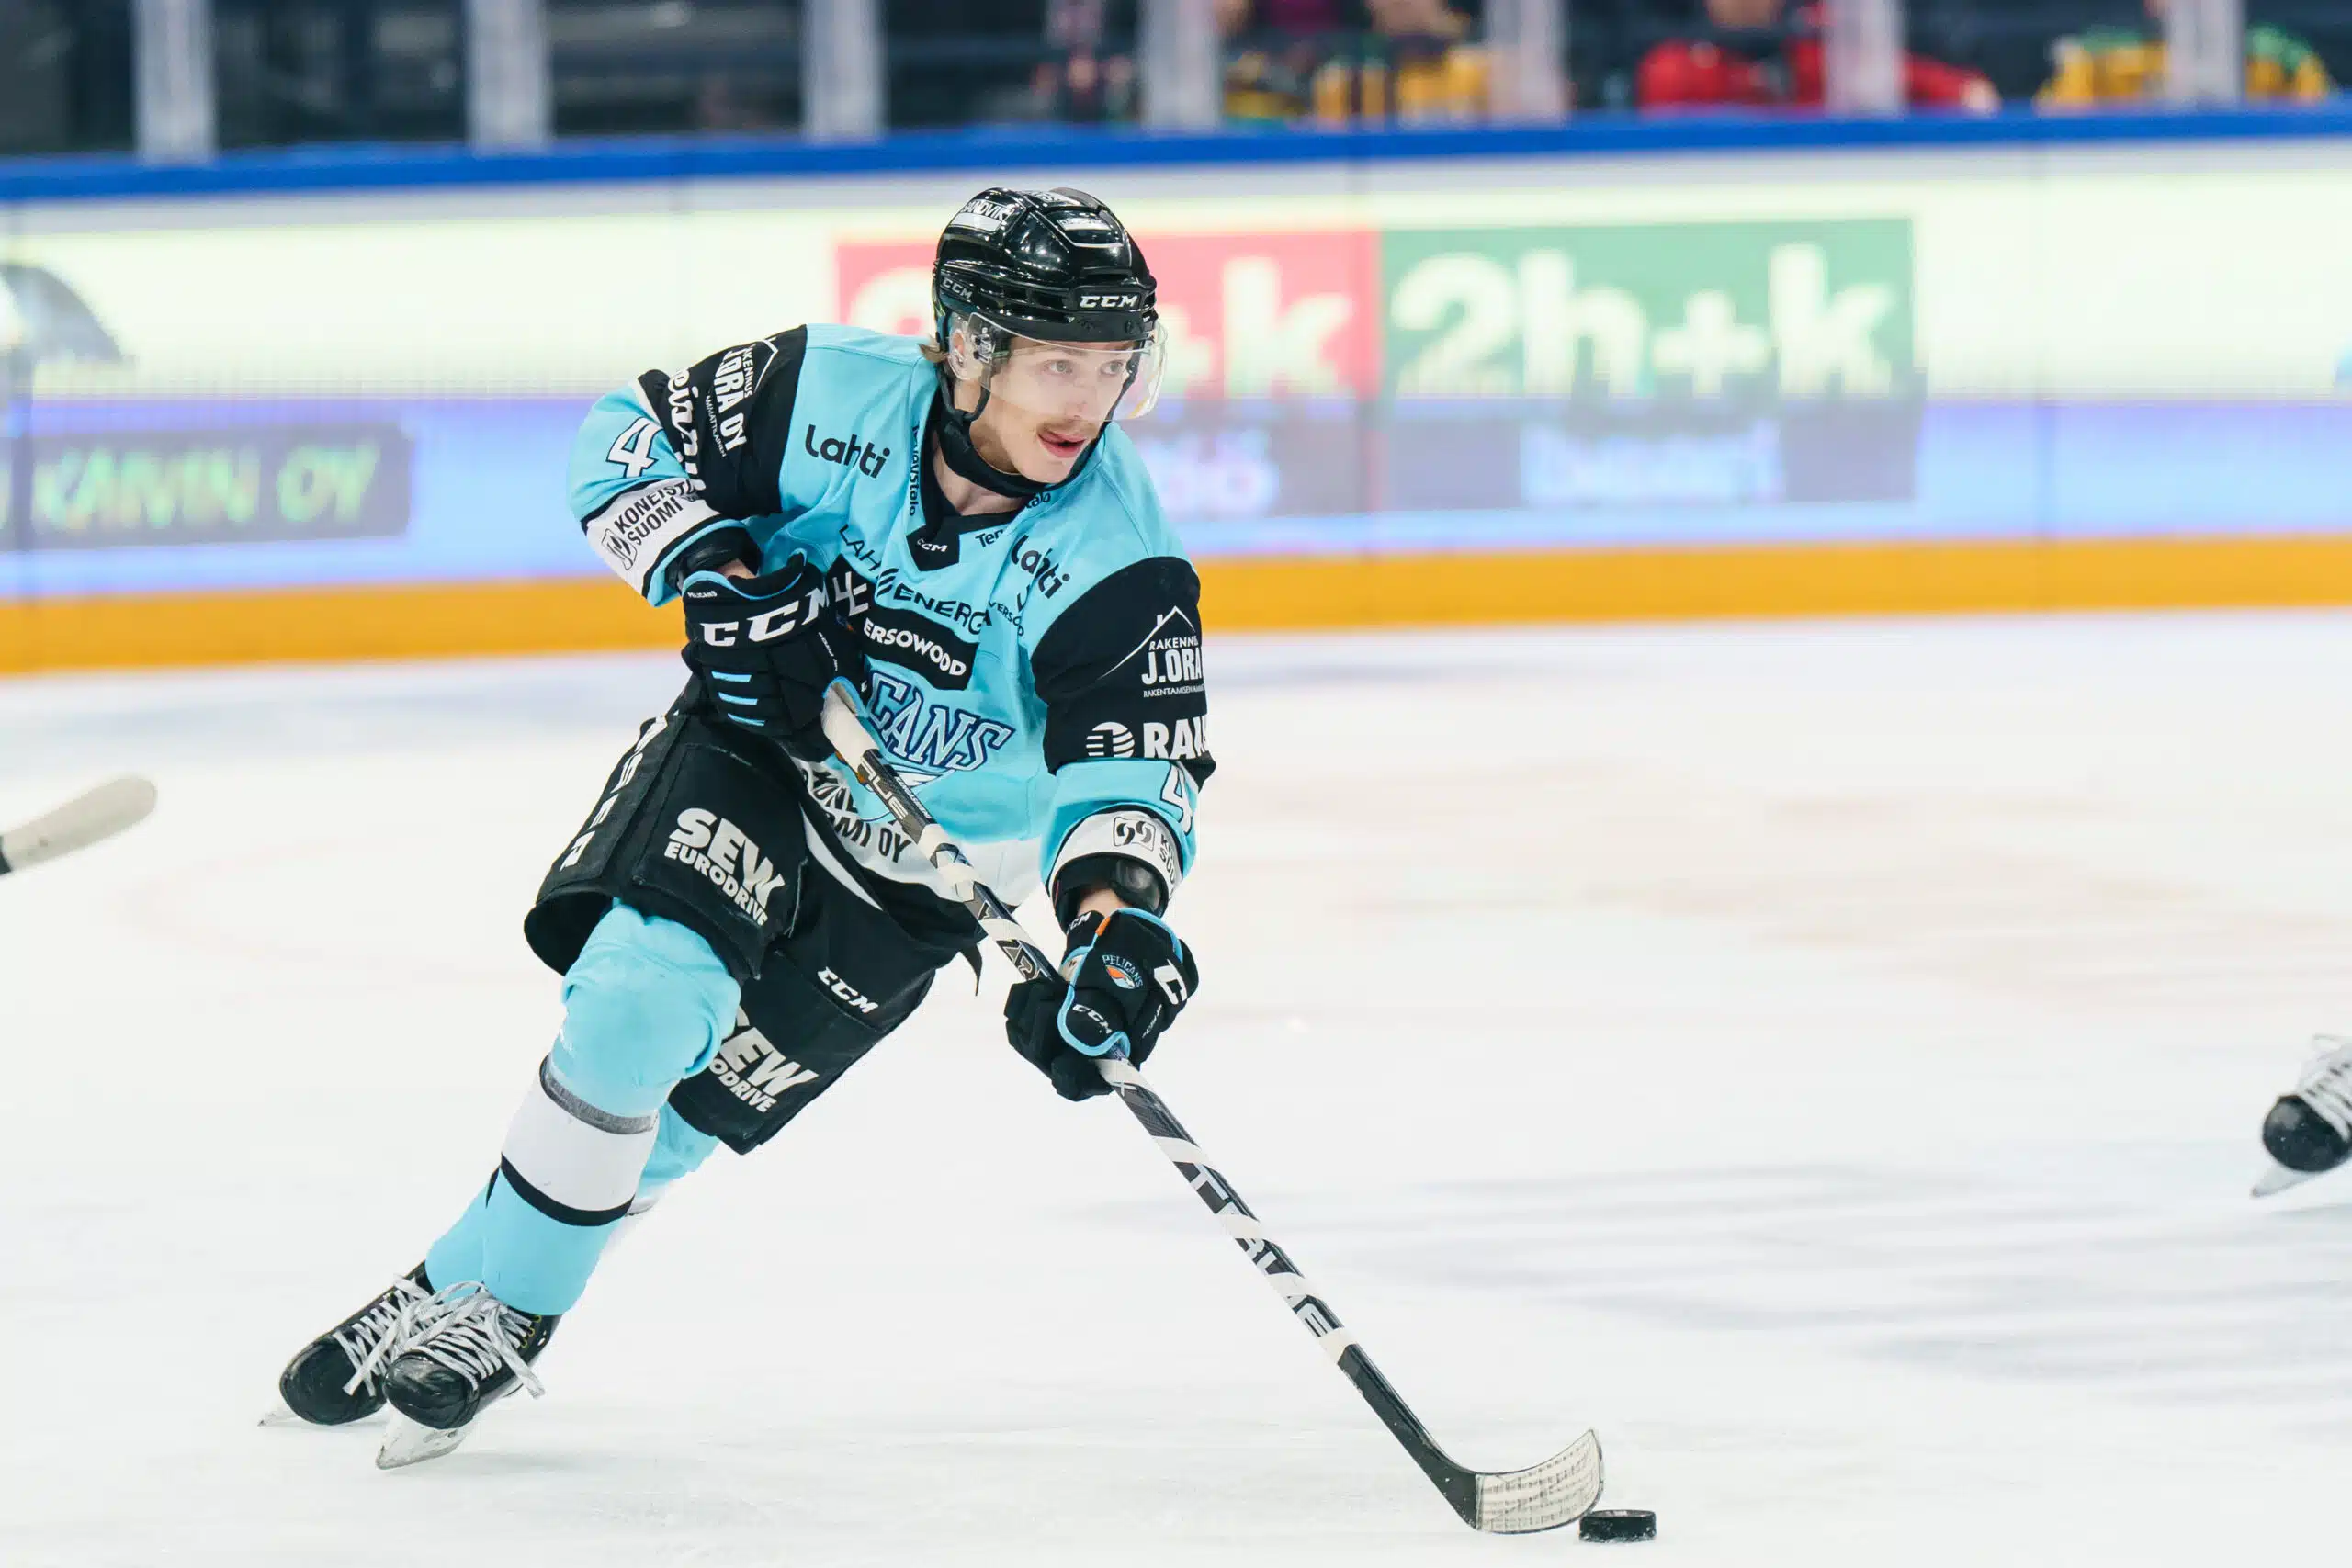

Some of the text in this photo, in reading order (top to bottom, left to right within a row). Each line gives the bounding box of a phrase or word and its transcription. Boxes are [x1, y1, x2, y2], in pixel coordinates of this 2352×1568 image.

[943, 277, 973, 299] CCM
[1080, 294, 1138, 310] CCM
[1389, 243, 1894, 399] 2h+k
[606, 416, 665, 479] 4
[720, 412, 747, 451] OY
[805, 424, 890, 478] Lahti
[627, 497, 684, 546] SUOMI
[839, 524, 882, 571] LAH
[700, 588, 830, 647] CCM
[864, 616, 967, 677] ERSOWOOD
[869, 671, 1015, 772] CANS
[860, 761, 909, 819] RUE
[1159, 764, 1193, 836] 4
[669, 807, 786, 908] SEW
[878, 828, 911, 863] OY
[664, 841, 768, 926] EURODRIVE
[1066, 911, 1091, 935] CM
[817, 966, 879, 1014] CCM
[1102, 954, 1144, 987] PELICANS
[708, 1058, 777, 1113] ODRIVE
[719, 1027, 820, 1097] EW
